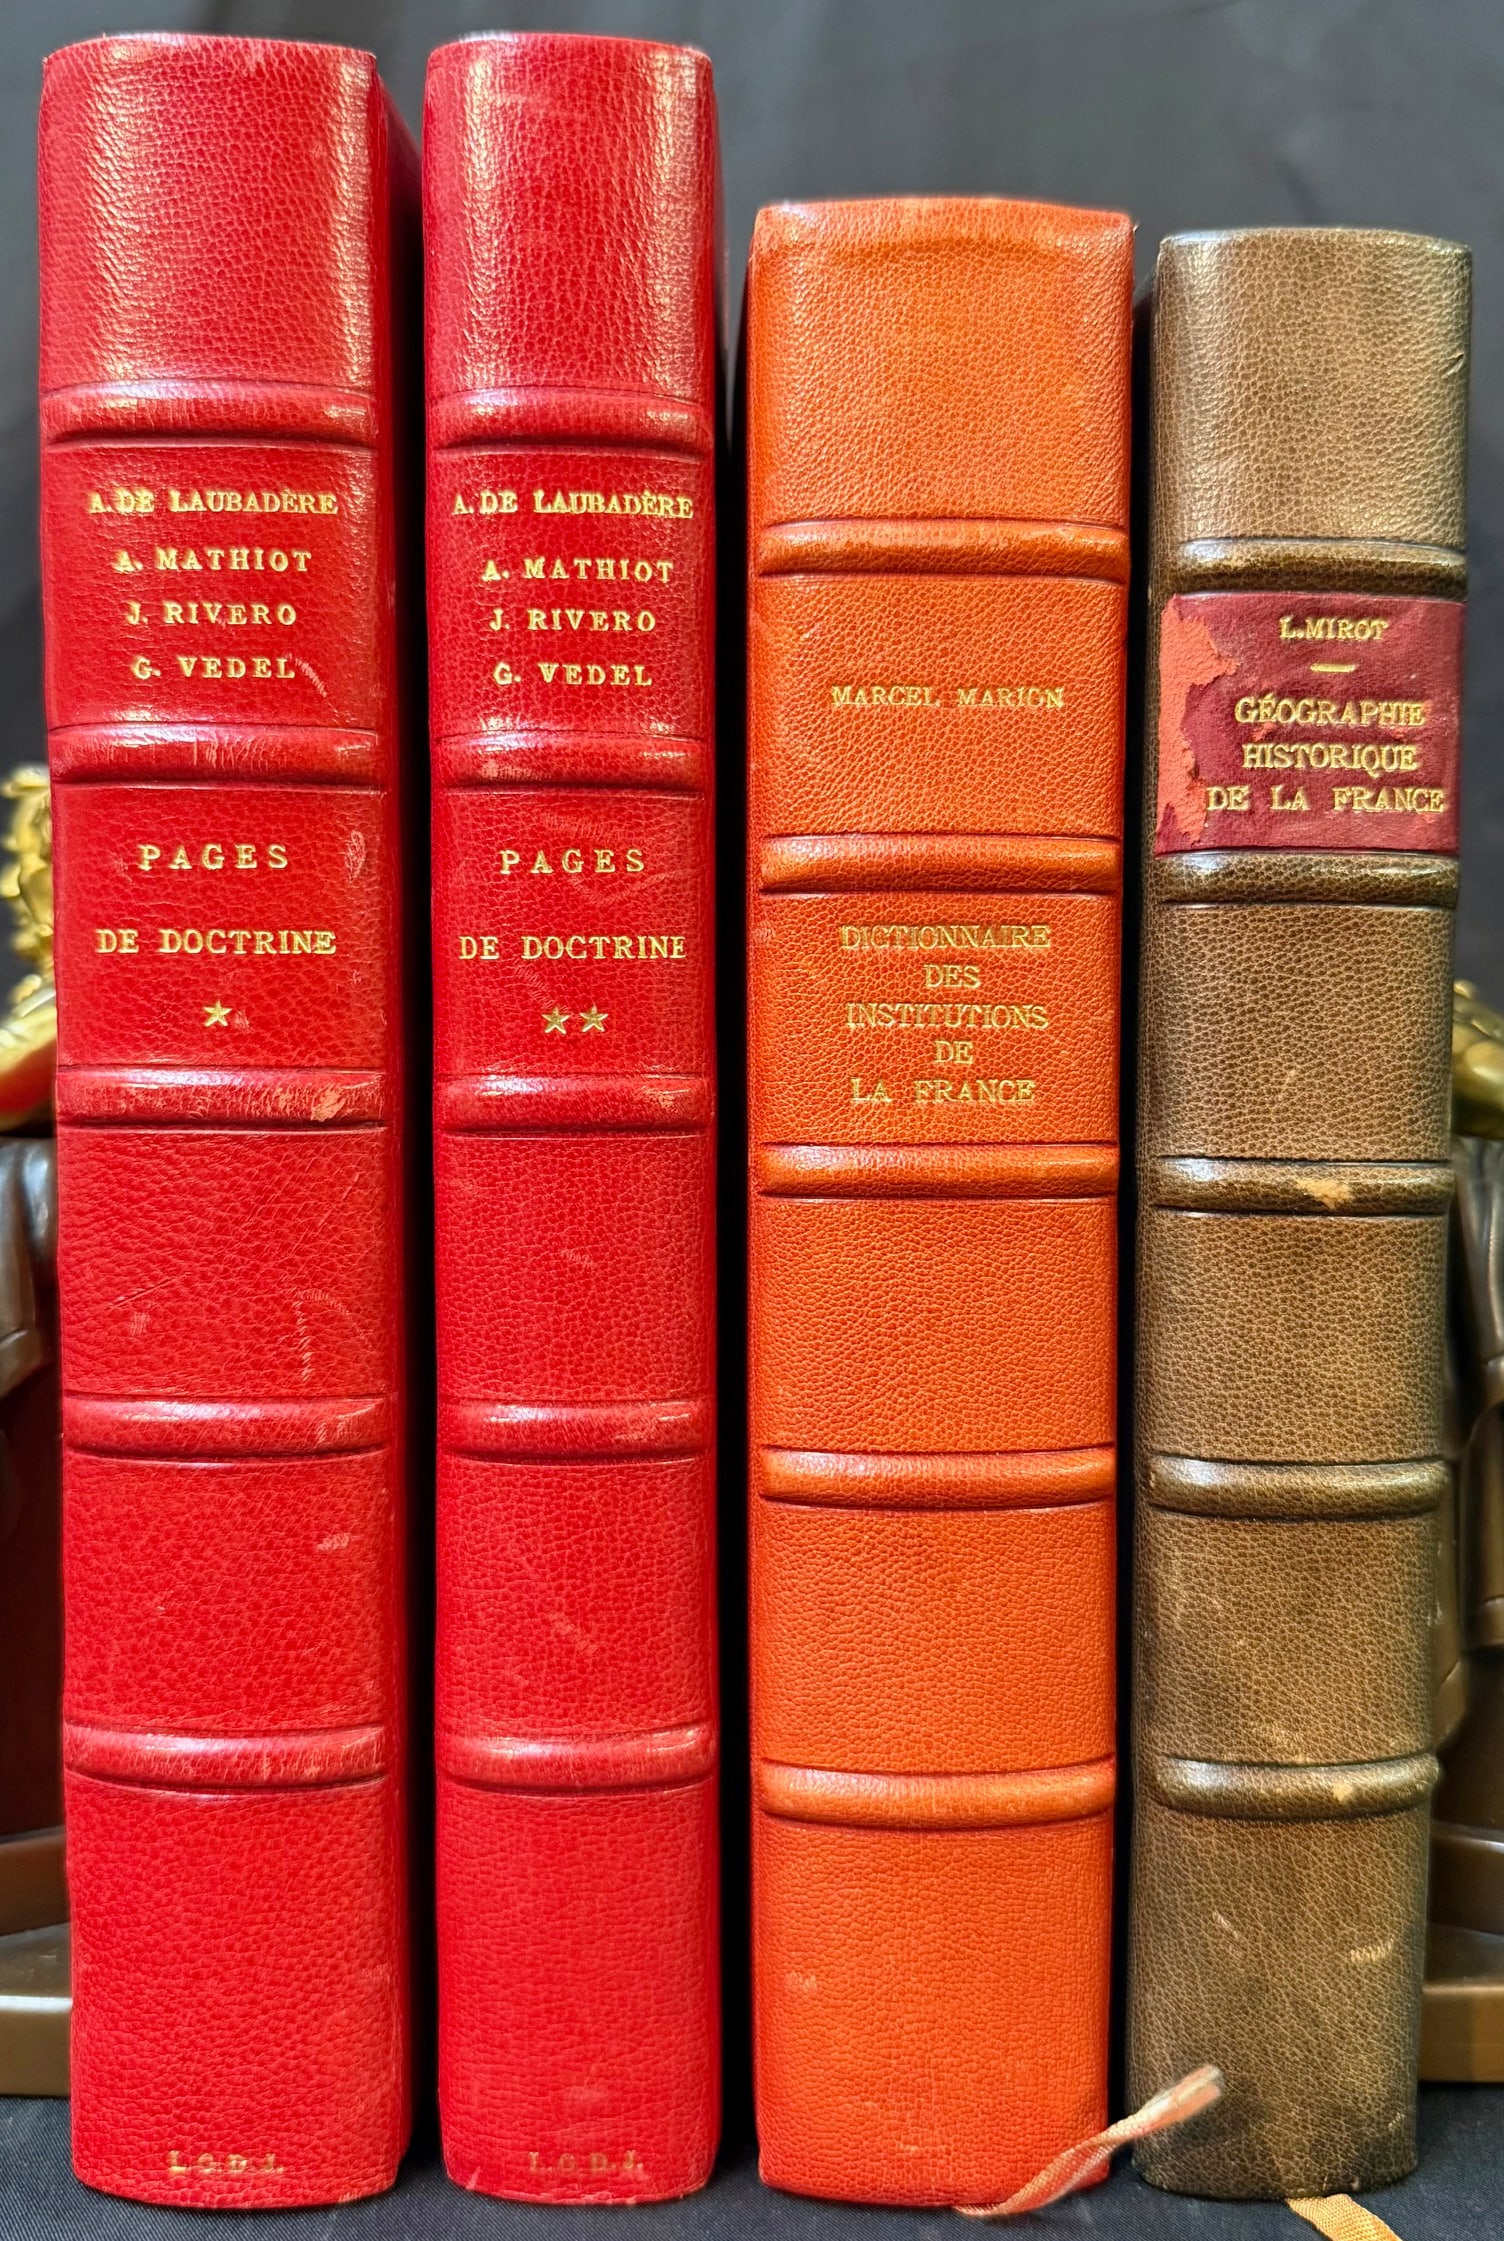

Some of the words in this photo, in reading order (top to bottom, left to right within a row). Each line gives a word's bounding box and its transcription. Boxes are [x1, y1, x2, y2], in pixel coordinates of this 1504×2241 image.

[168, 488, 338, 515] LAUBADÈRE
[533, 489, 694, 519] LAUBADÈRE
[112, 550, 143, 573] A.
[155, 548, 312, 572] MATHIOT
[481, 560, 510, 582] A.
[523, 557, 674, 583] MATHIOT
[126, 601, 148, 624] J.
[163, 601, 297, 625] RIVERO
[489, 609, 510, 630] J.
[527, 608, 656, 631] RIVERO
[1279, 615, 1388, 640] L.MIROT
[133, 656, 161, 680] G.
[178, 657, 295, 679] VEDEL
[493, 662, 521, 685] G.
[538, 663, 652, 686] VEDEL
[831, 684, 941, 708] MARCEL
[956, 687, 1065, 709] MARION
[1234, 692, 1426, 726] GÉOGRAPHIE
[1242, 743, 1418, 779] HISTORIQUE
[1206, 786, 1249, 811] DE
[1271, 785, 1310, 811] LA
[1333, 786, 1446, 813] FRANCE
[137, 844, 288, 871] PAGES
[500, 850, 645, 875] PAGES
[95, 928, 139, 954] DE
[159, 928, 337, 955] DOCTRINE
[459, 935, 499, 960] DE
[521, 935, 686, 960] DOCTRINE
[841, 924, 1051, 950] DICTIONNAIRE
[923, 964, 981, 988] DES
[846, 1003, 1049, 1029] INSTITUTIONS
[933, 1040, 974, 1064] DE
[851, 1077, 892, 1104] LA
[914, 1078, 1036, 1105] FRANCE
